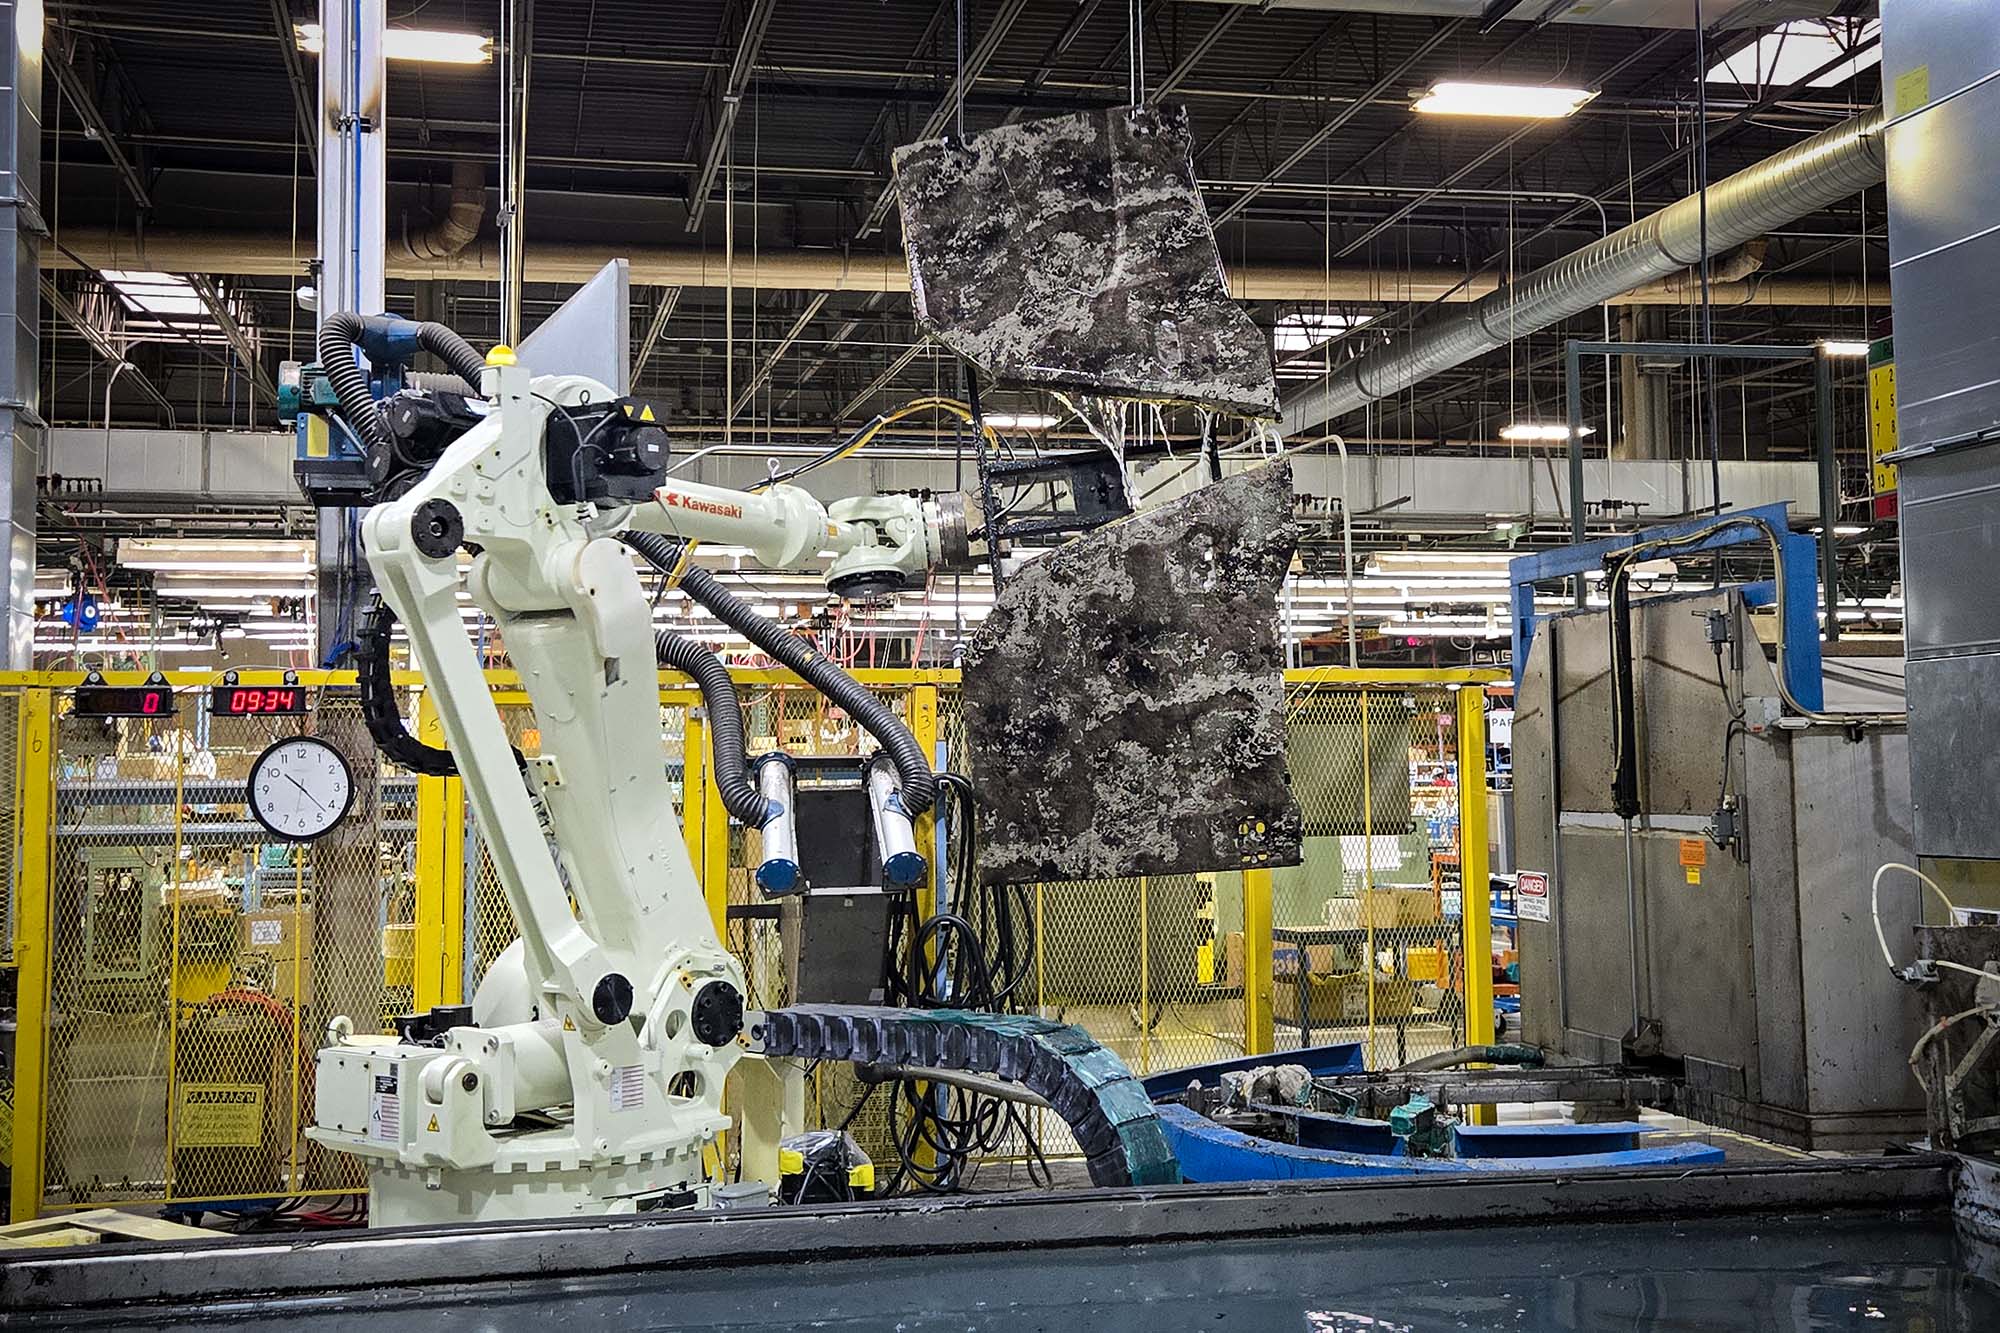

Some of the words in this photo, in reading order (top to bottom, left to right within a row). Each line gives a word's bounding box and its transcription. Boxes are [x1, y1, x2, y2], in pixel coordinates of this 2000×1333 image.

[1875, 398, 1880, 412] 4
[1889, 393, 1895, 407] 5
[1877, 474, 1885, 489] 13
[682, 496, 743, 519] Kawasaki
[143, 692, 160, 713] 0
[230, 690, 294, 712] 09:34
[921, 714, 932, 730] 3
[32, 730, 43, 753] 6
[280, 754, 288, 764] 11
[297, 748, 307, 759] 12
[267, 768, 281, 778] 10
[328, 765, 336, 775] 2
[262, 785, 270, 795] 9
[334, 782, 341, 792] 3
[267, 802, 274, 812] 8
[328, 800, 335, 809] 4
[283, 814, 289, 825] 7
[298, 818, 306, 828] 6
[316, 812, 323, 823] 5
[1520, 878, 1545, 893] DANGER
[189, 1091, 256, 1104] CAUTION
